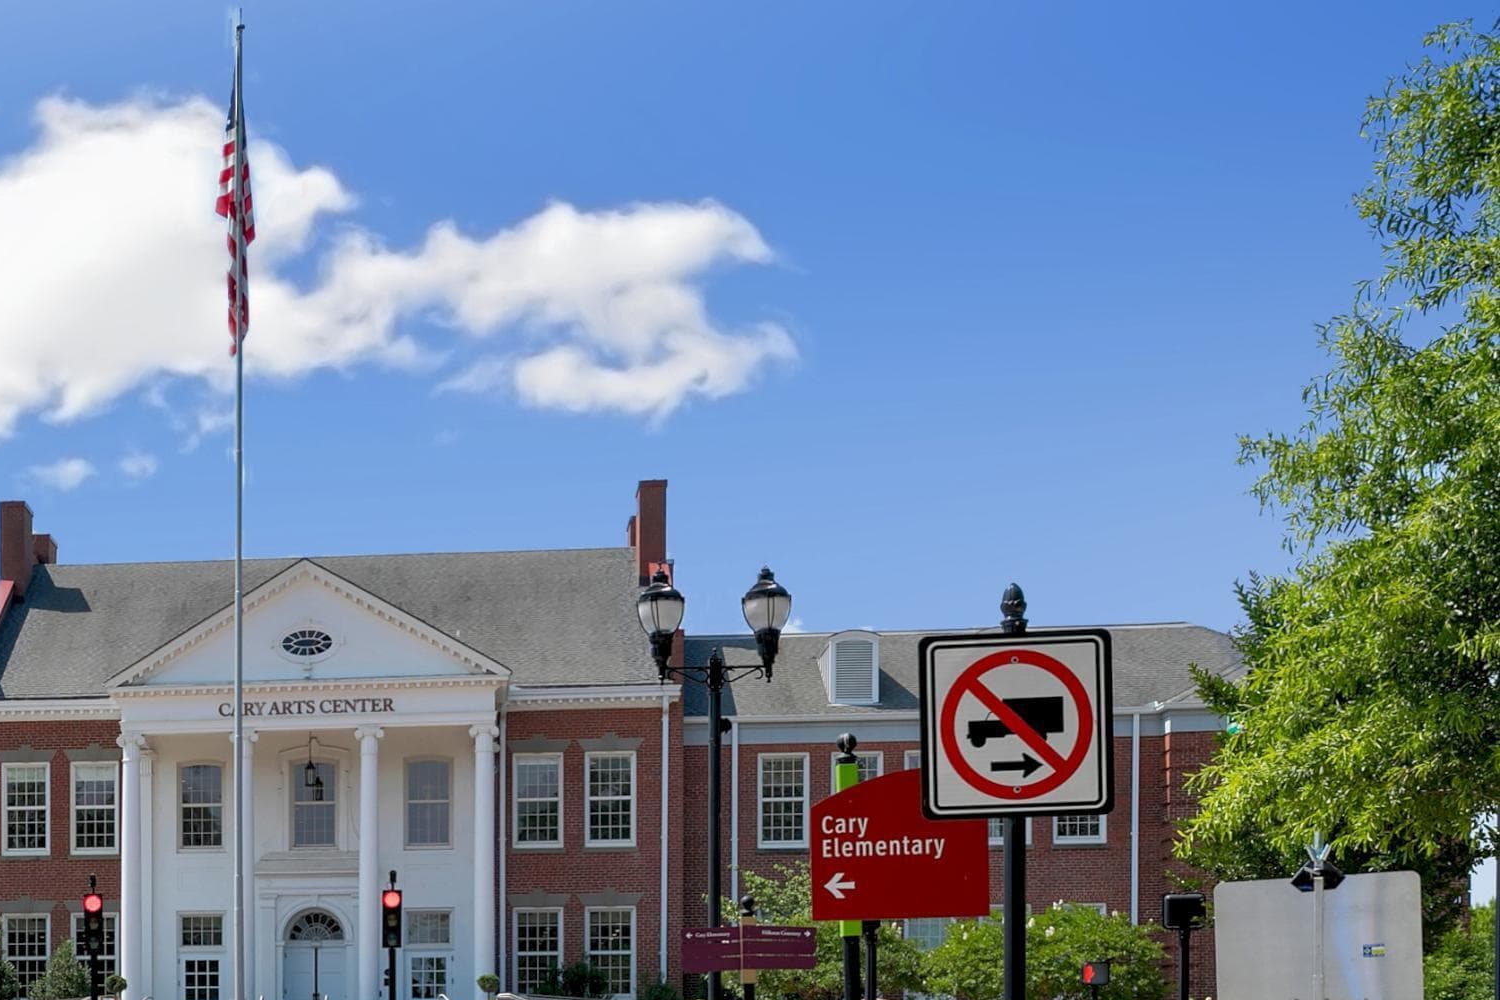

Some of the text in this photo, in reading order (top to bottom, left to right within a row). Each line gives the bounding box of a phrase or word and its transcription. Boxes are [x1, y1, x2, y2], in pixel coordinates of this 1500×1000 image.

[218, 698, 395, 717] CRY ARTS CENTER
[821, 815, 868, 838] Cary
[822, 836, 945, 859] Elementary
